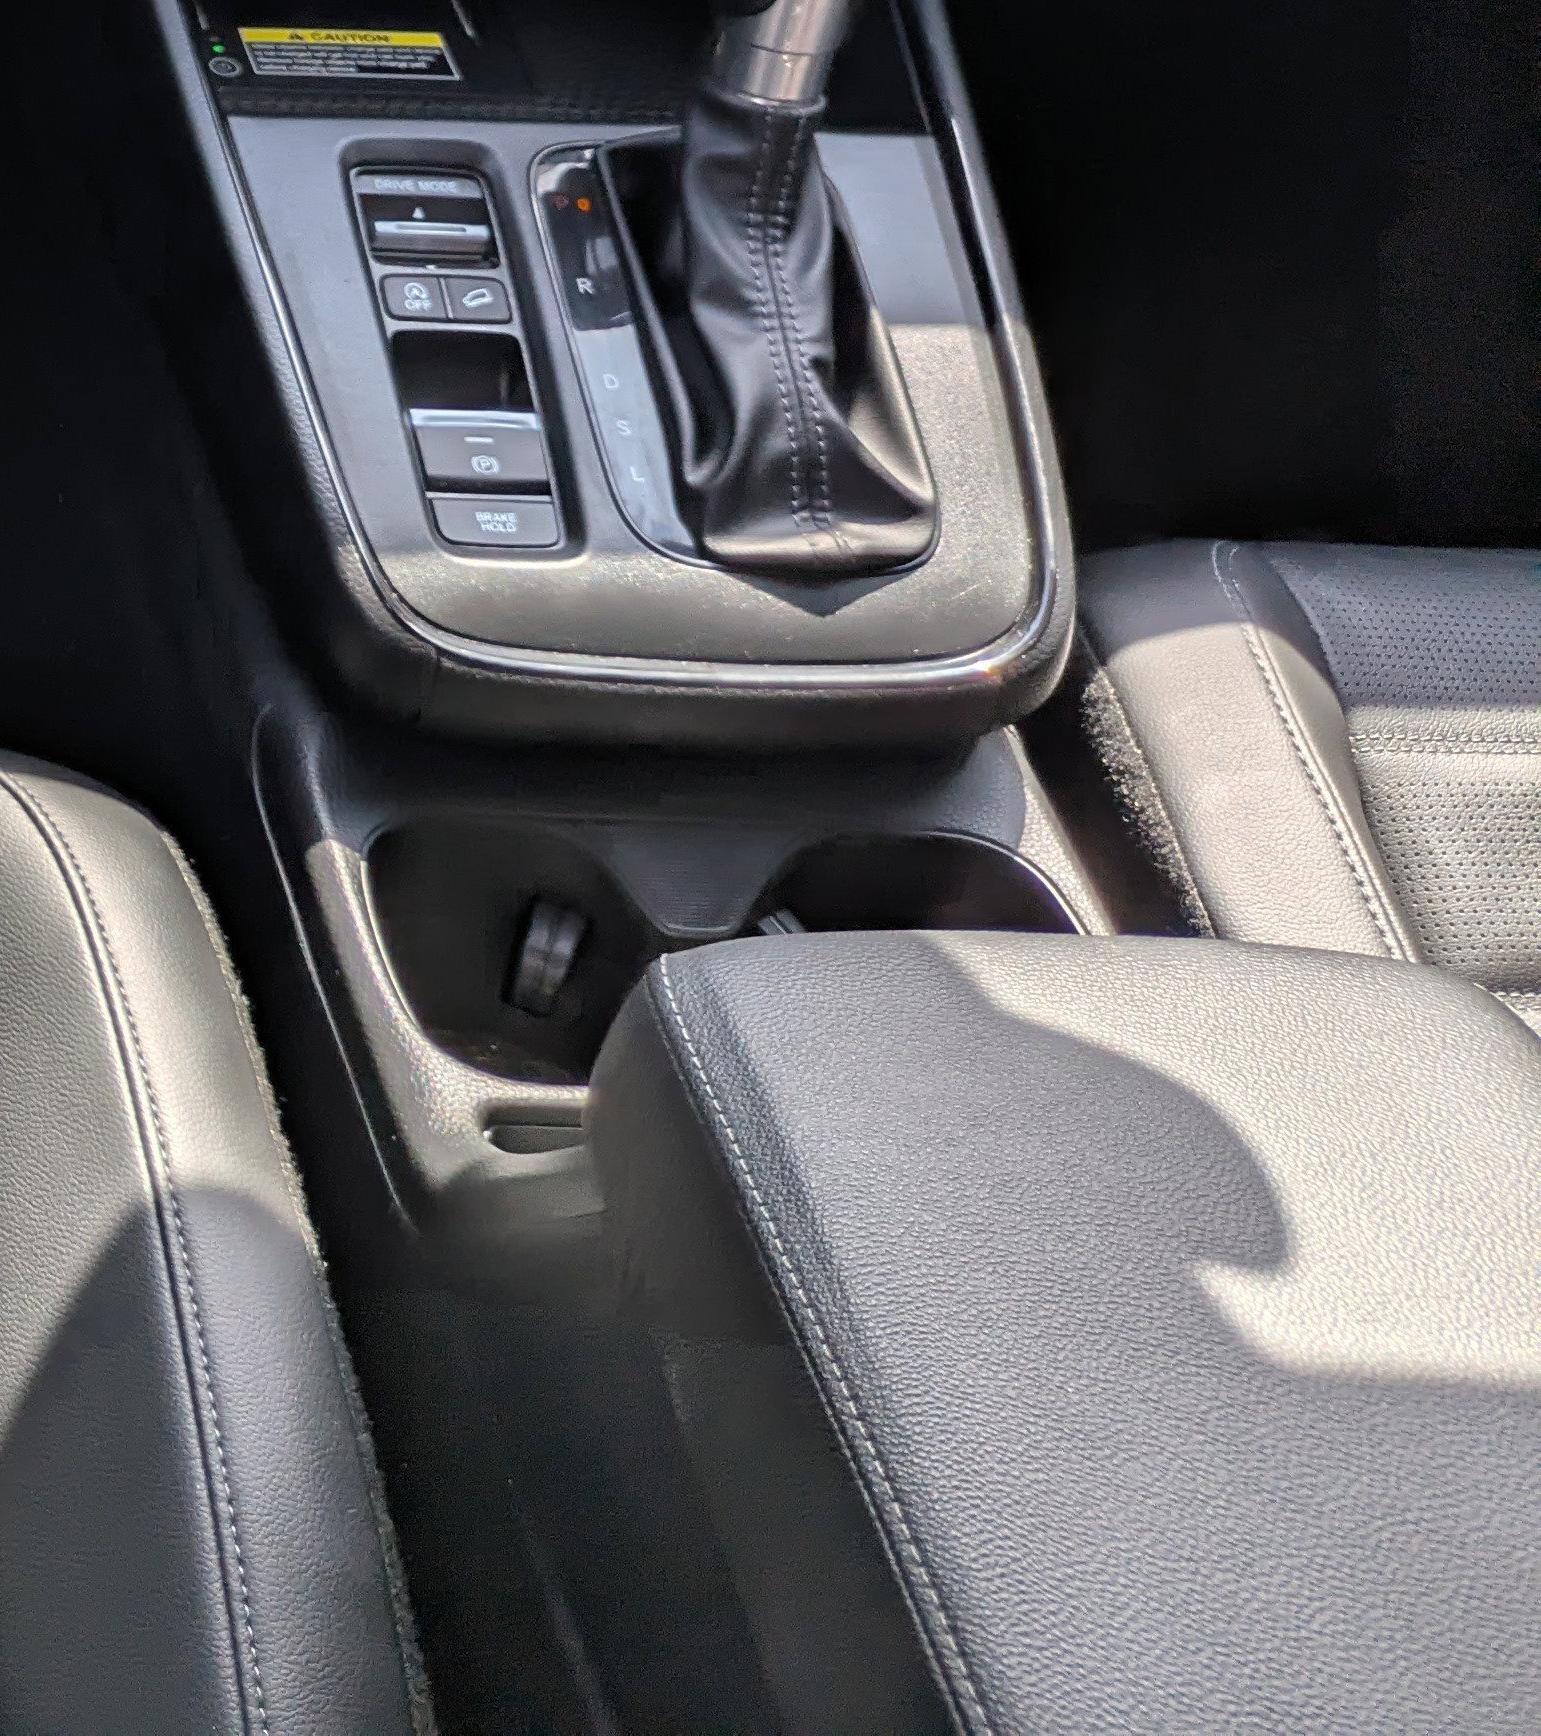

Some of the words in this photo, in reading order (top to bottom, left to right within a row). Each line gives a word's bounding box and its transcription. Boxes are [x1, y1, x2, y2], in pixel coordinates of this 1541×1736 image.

[309, 32, 392, 43] CAUTION
[374, 178, 415, 192] DRIVE
[576, 277, 595, 295] R
[405, 298, 432, 311] OFF
[603, 373, 620, 390] D
[617, 420, 632, 436] S
[629, 465, 645, 482] L
[475, 511, 517, 523] BRAKE
[480, 523, 517, 534] HOLD
